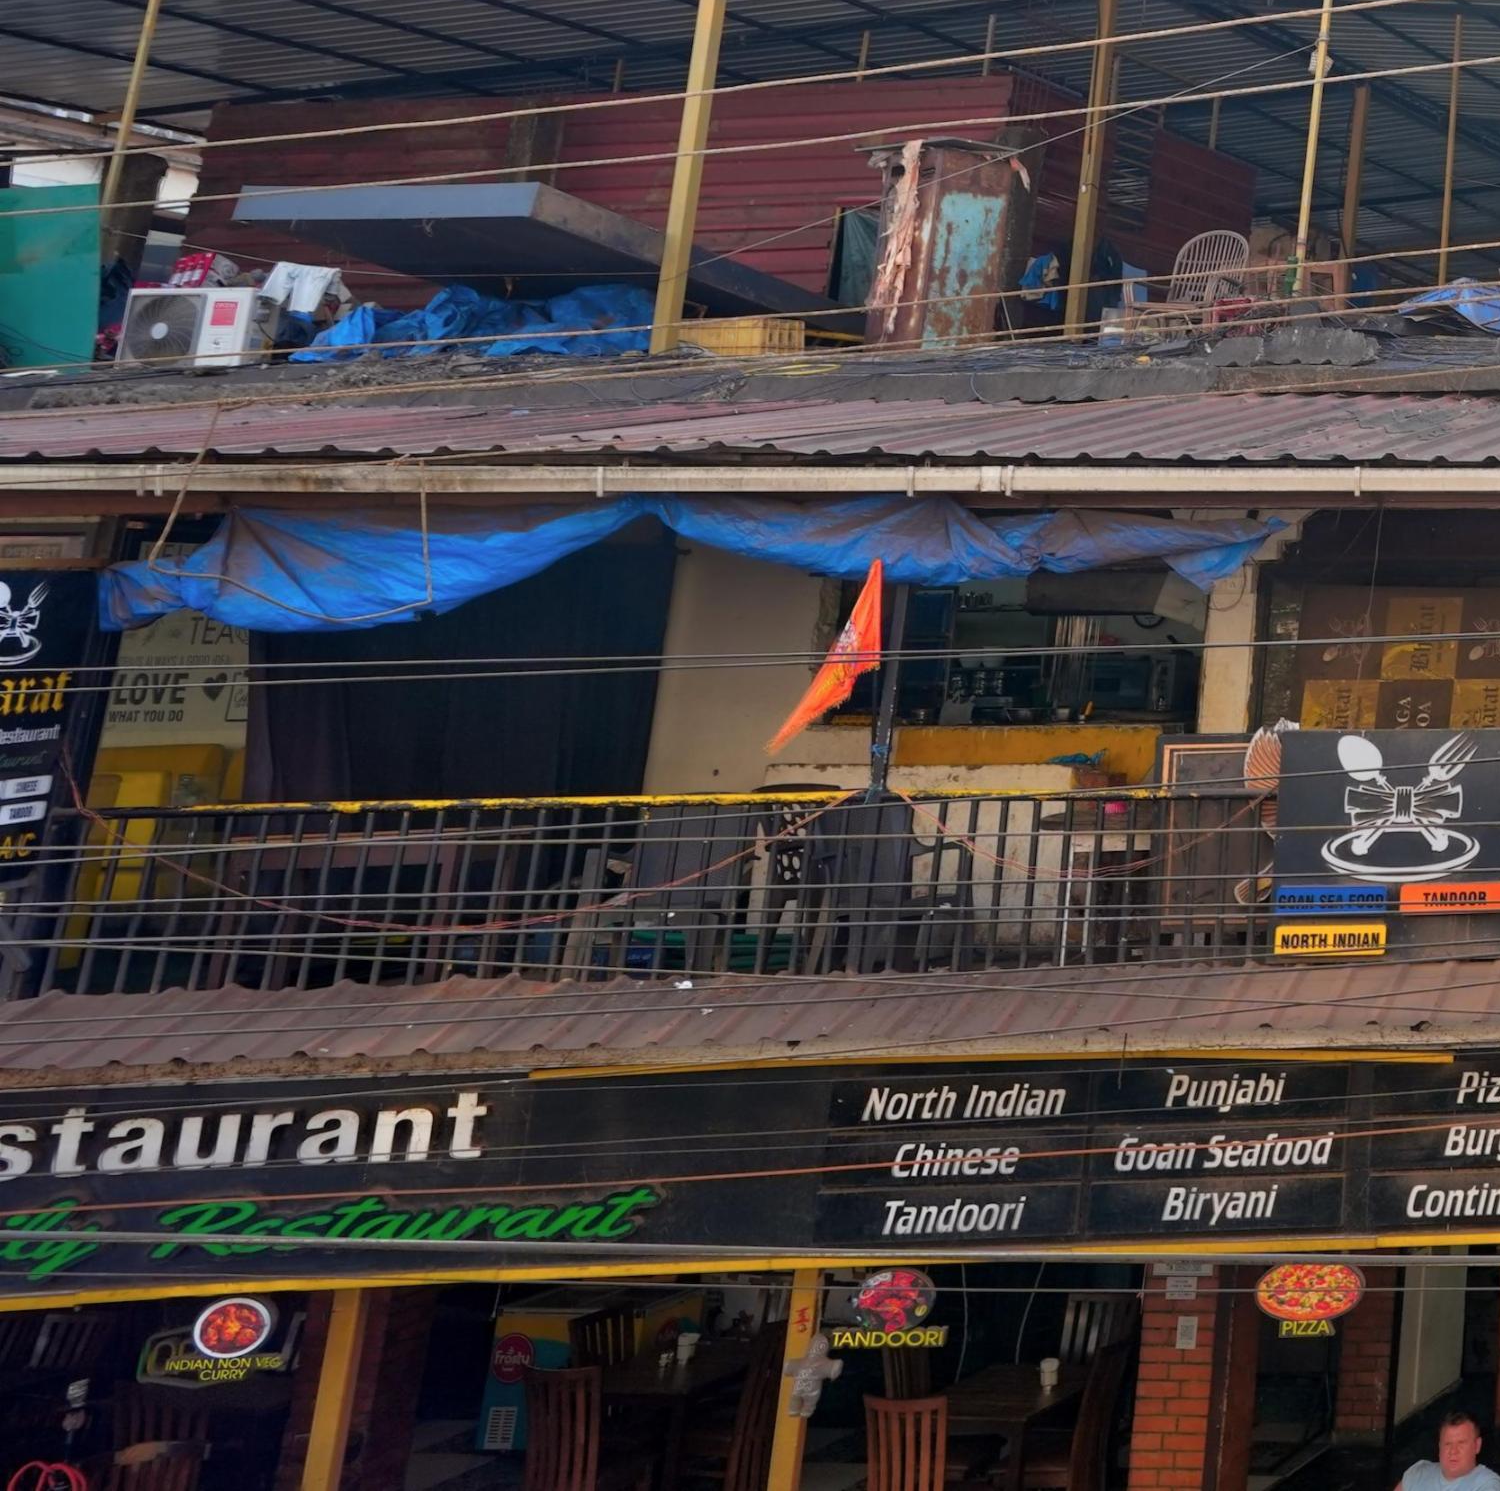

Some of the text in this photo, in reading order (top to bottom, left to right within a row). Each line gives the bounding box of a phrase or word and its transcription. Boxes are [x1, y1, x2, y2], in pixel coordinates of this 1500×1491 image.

[111, 672, 190, 706] LOVE
[107, 709, 185, 723] WHAT YOU DO
[1279, 893, 1384, 909] GOAN SEA FOOD
[1423, 891, 1487, 907] TANDOOR
[1281, 932, 1380, 950] NORTH INDIAN
[862, 1083, 1067, 1123] North Indian
[1165, 1072, 1287, 1113] Punjabi
[0, 1092, 488, 1182] staurant
[1114, 1131, 1335, 1173] Goan Seafood
[891, 1143, 1020, 1180] Chinese
[150, 1186, 660, 1258] Restaurant
[882, 1195, 1025, 1236] Tandoori
[1161, 1185, 1278, 1226] Biryani
[832, 1330, 945, 1348] TANDOORI
[1280, 1319, 1331, 1336] PIZZA
[165, 1356, 284, 1371] INDIAN NON VEG
[199, 1369, 247, 1382] CURRY
